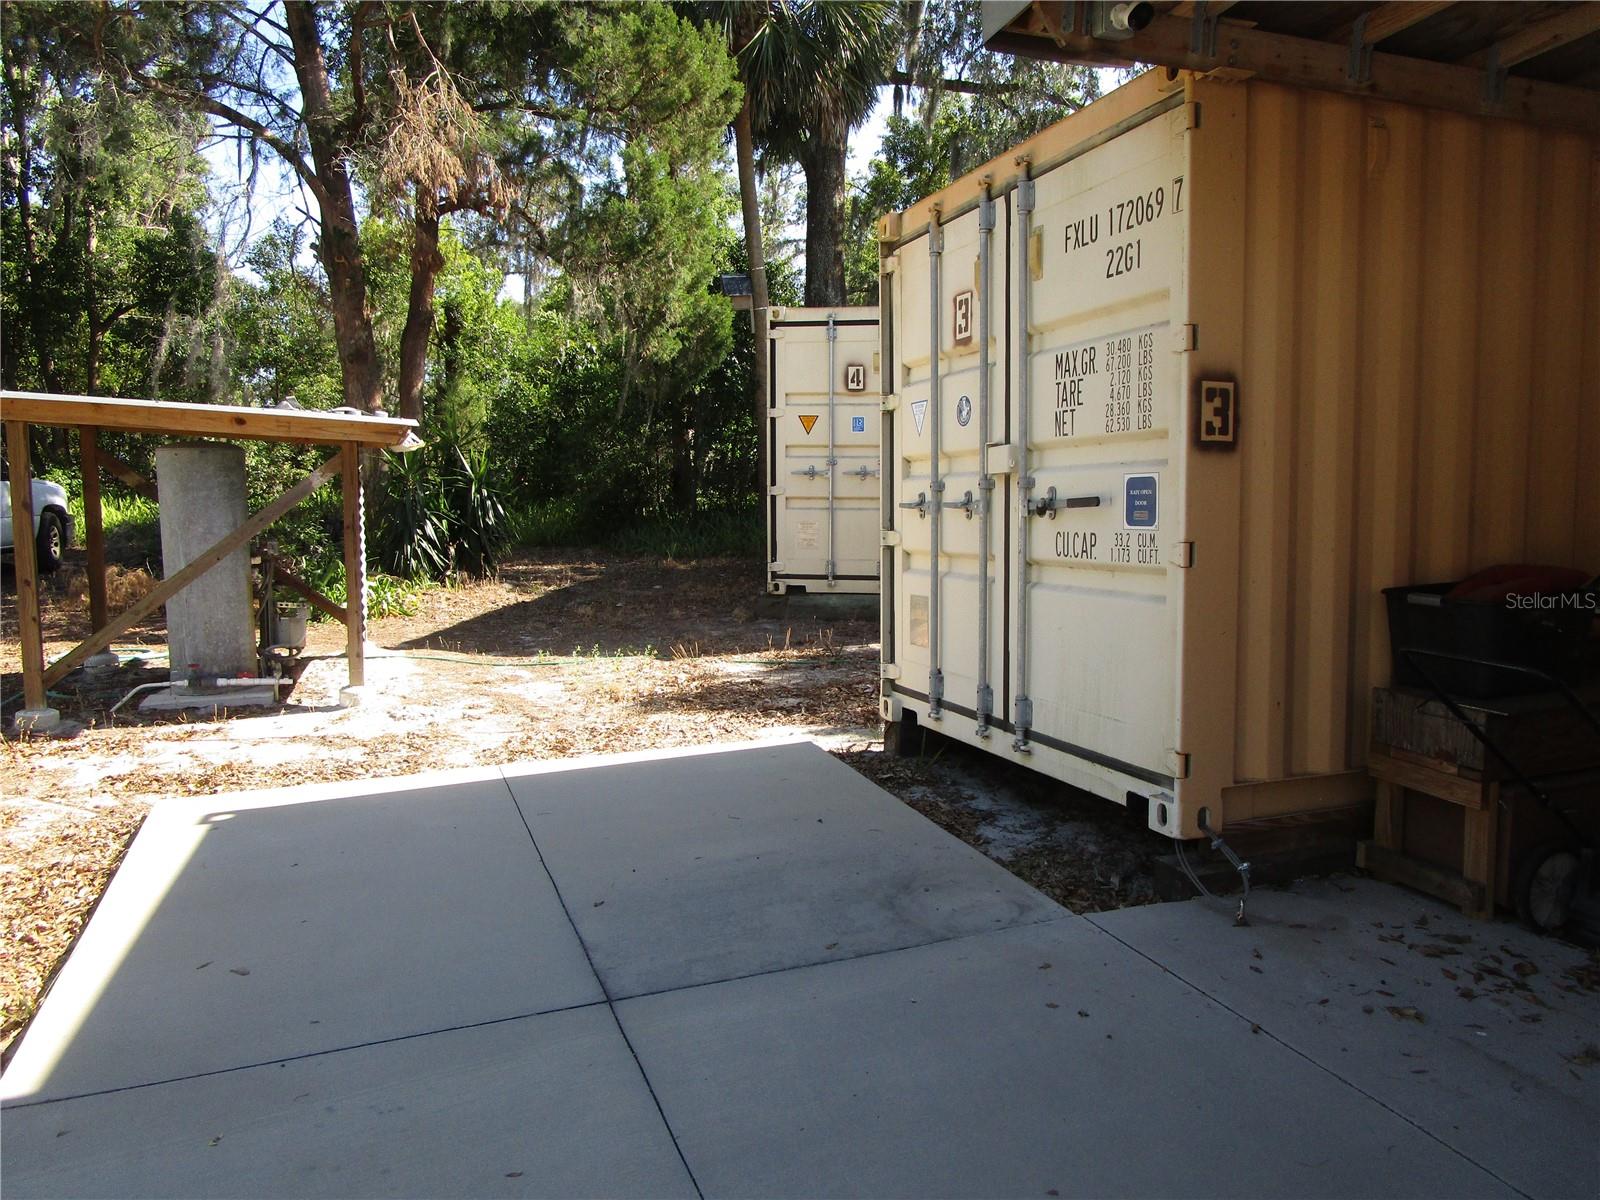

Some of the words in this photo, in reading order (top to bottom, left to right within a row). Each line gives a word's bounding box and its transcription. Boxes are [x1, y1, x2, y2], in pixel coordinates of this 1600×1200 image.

[1064, 213, 1099, 254] FXLU
[1108, 186, 1165, 237] 172069
[1174, 177, 1184, 211] 7
[1106, 239, 1142, 279] 22G1
[957, 297, 970, 335] 3
[1138, 332, 1153, 350] KGS
[1055, 346, 1099, 380] MAX.GR.
[1105, 353, 1131, 372] 67.200
[1138, 349, 1153, 366] LBS
[850, 368, 861, 387] 4
[1110, 369, 1131, 387] 2.120
[1138, 365, 1153, 382] KGS
[1055, 378, 1084, 409] TARE
[1109, 384, 1131, 402] 4.670
[1137, 381, 1153, 398] LBS
[1105, 400, 1131, 418] 28.360
[1137, 397, 1153, 414] KGS
[1205, 387, 1231, 436] 3
[1054, 408, 1076, 437] NET
[1105, 416, 1131, 433] 62.530
[1137, 413, 1153, 430] LBS
[1055, 531, 1097, 560] CU.CAP.
[1114, 532, 1131, 548] 33.2
[1137, 533, 1158, 548] CU.M.
[1110, 548, 1131, 563] 1.173
[1137, 548, 1161, 565] CU.FT.
